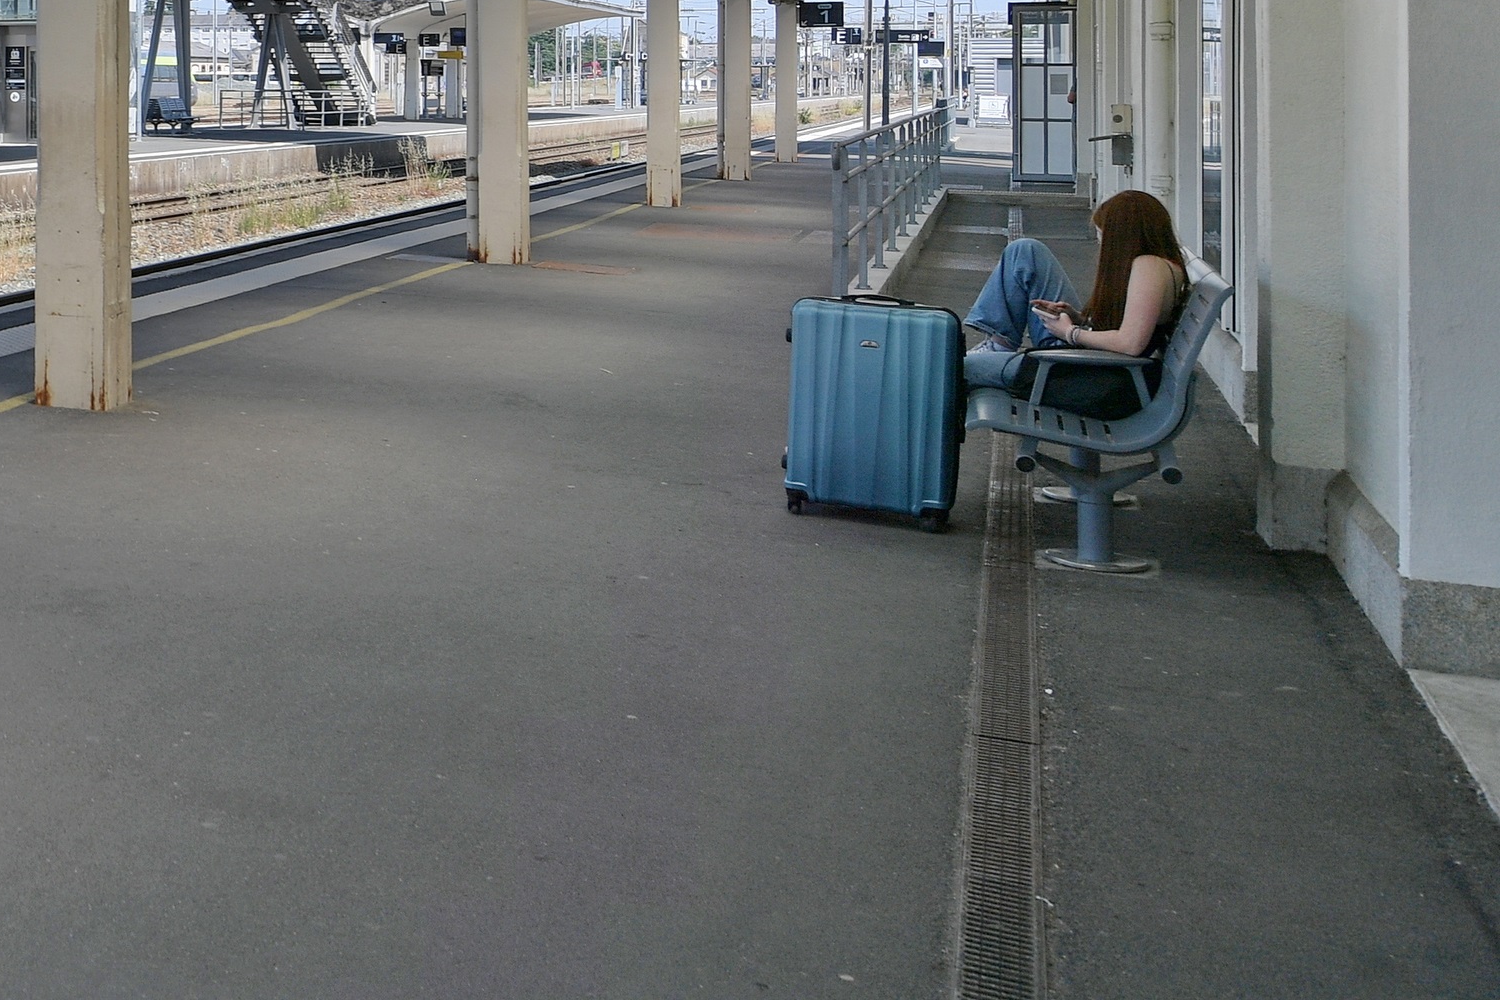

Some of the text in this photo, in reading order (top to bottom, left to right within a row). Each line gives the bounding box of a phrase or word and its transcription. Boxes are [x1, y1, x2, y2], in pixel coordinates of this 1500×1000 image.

[819, 10, 830, 24] 1
[423, 36, 430, 46] E
[836, 30, 847, 44] E
[396, 44, 403, 53] E
